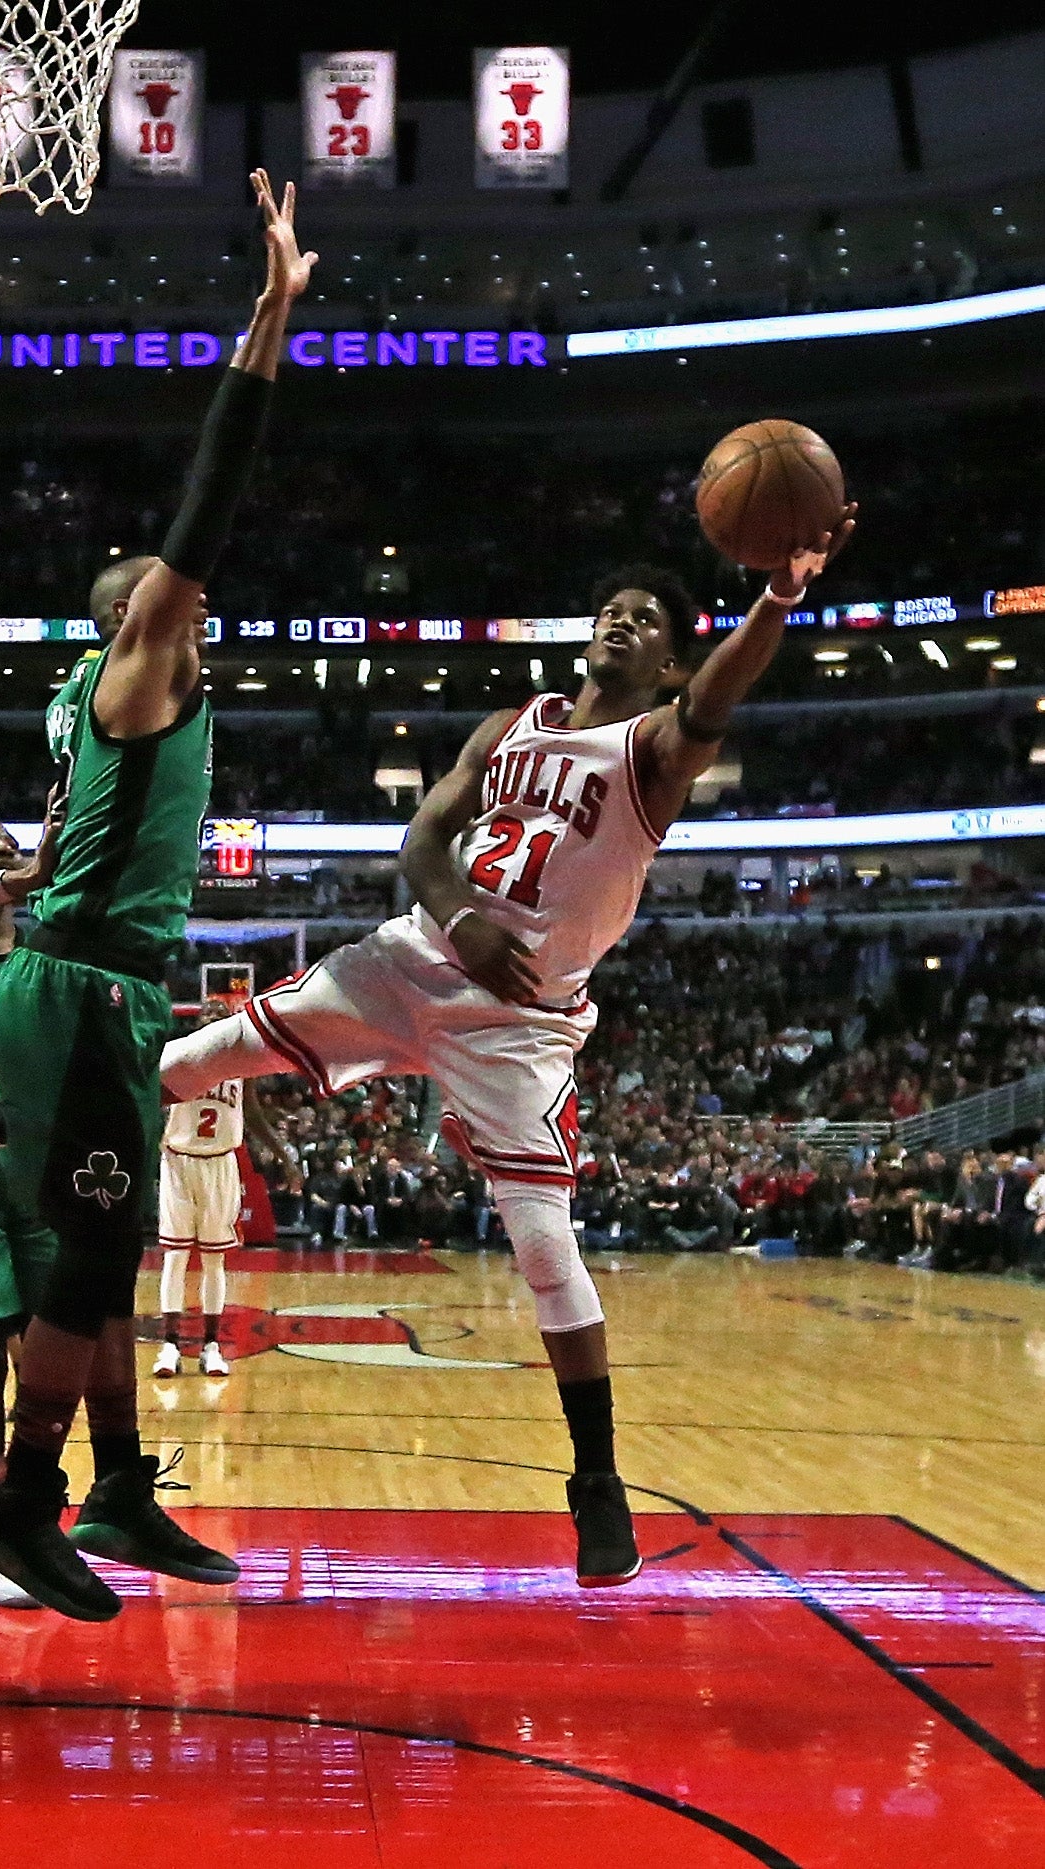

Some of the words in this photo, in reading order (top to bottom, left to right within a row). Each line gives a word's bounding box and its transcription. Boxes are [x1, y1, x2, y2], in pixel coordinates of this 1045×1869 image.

[139, 121, 174, 153] 10
[328, 125, 369, 156] 23
[500, 121, 541, 150] 33
[288, 331, 548, 366] CENTER
[894, 596, 951, 612] BOSTON
[894, 608, 957, 626] CHICAGO
[239, 620, 275, 637] 3:25
[419, 619, 462, 641] BULLS
[486, 751, 609, 840] BULLS
[469, 814, 557, 909] 21
[197, 1108, 218, 1137] 2
